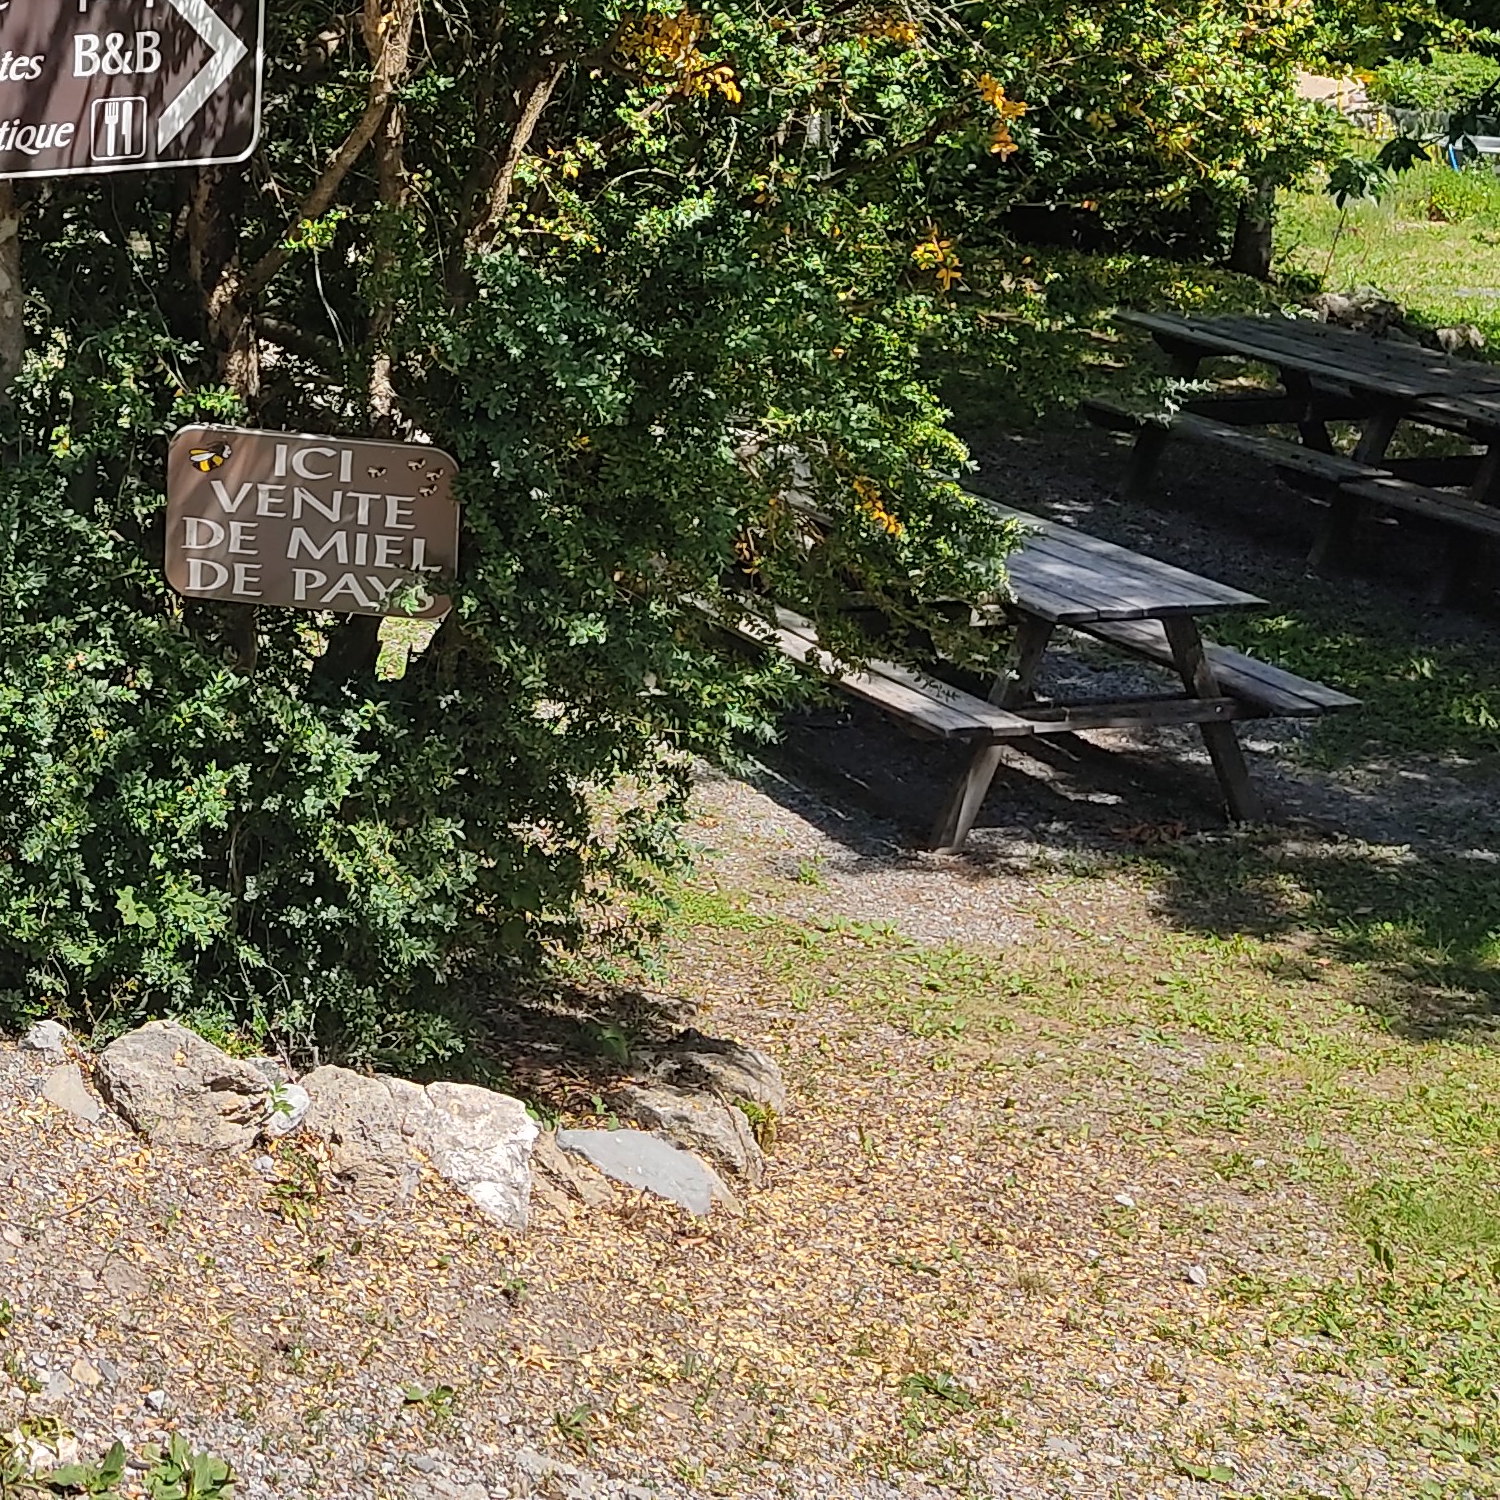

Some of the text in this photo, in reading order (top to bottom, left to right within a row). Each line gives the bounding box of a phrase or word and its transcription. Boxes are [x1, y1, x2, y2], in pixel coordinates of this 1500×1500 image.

[72, 31, 162, 78] B&B
[273, 444, 353, 482] ICI
[211, 480, 416, 529] VENTE
[180, 516, 443, 573] DE MIEL
[184, 557, 262, 597] DE
